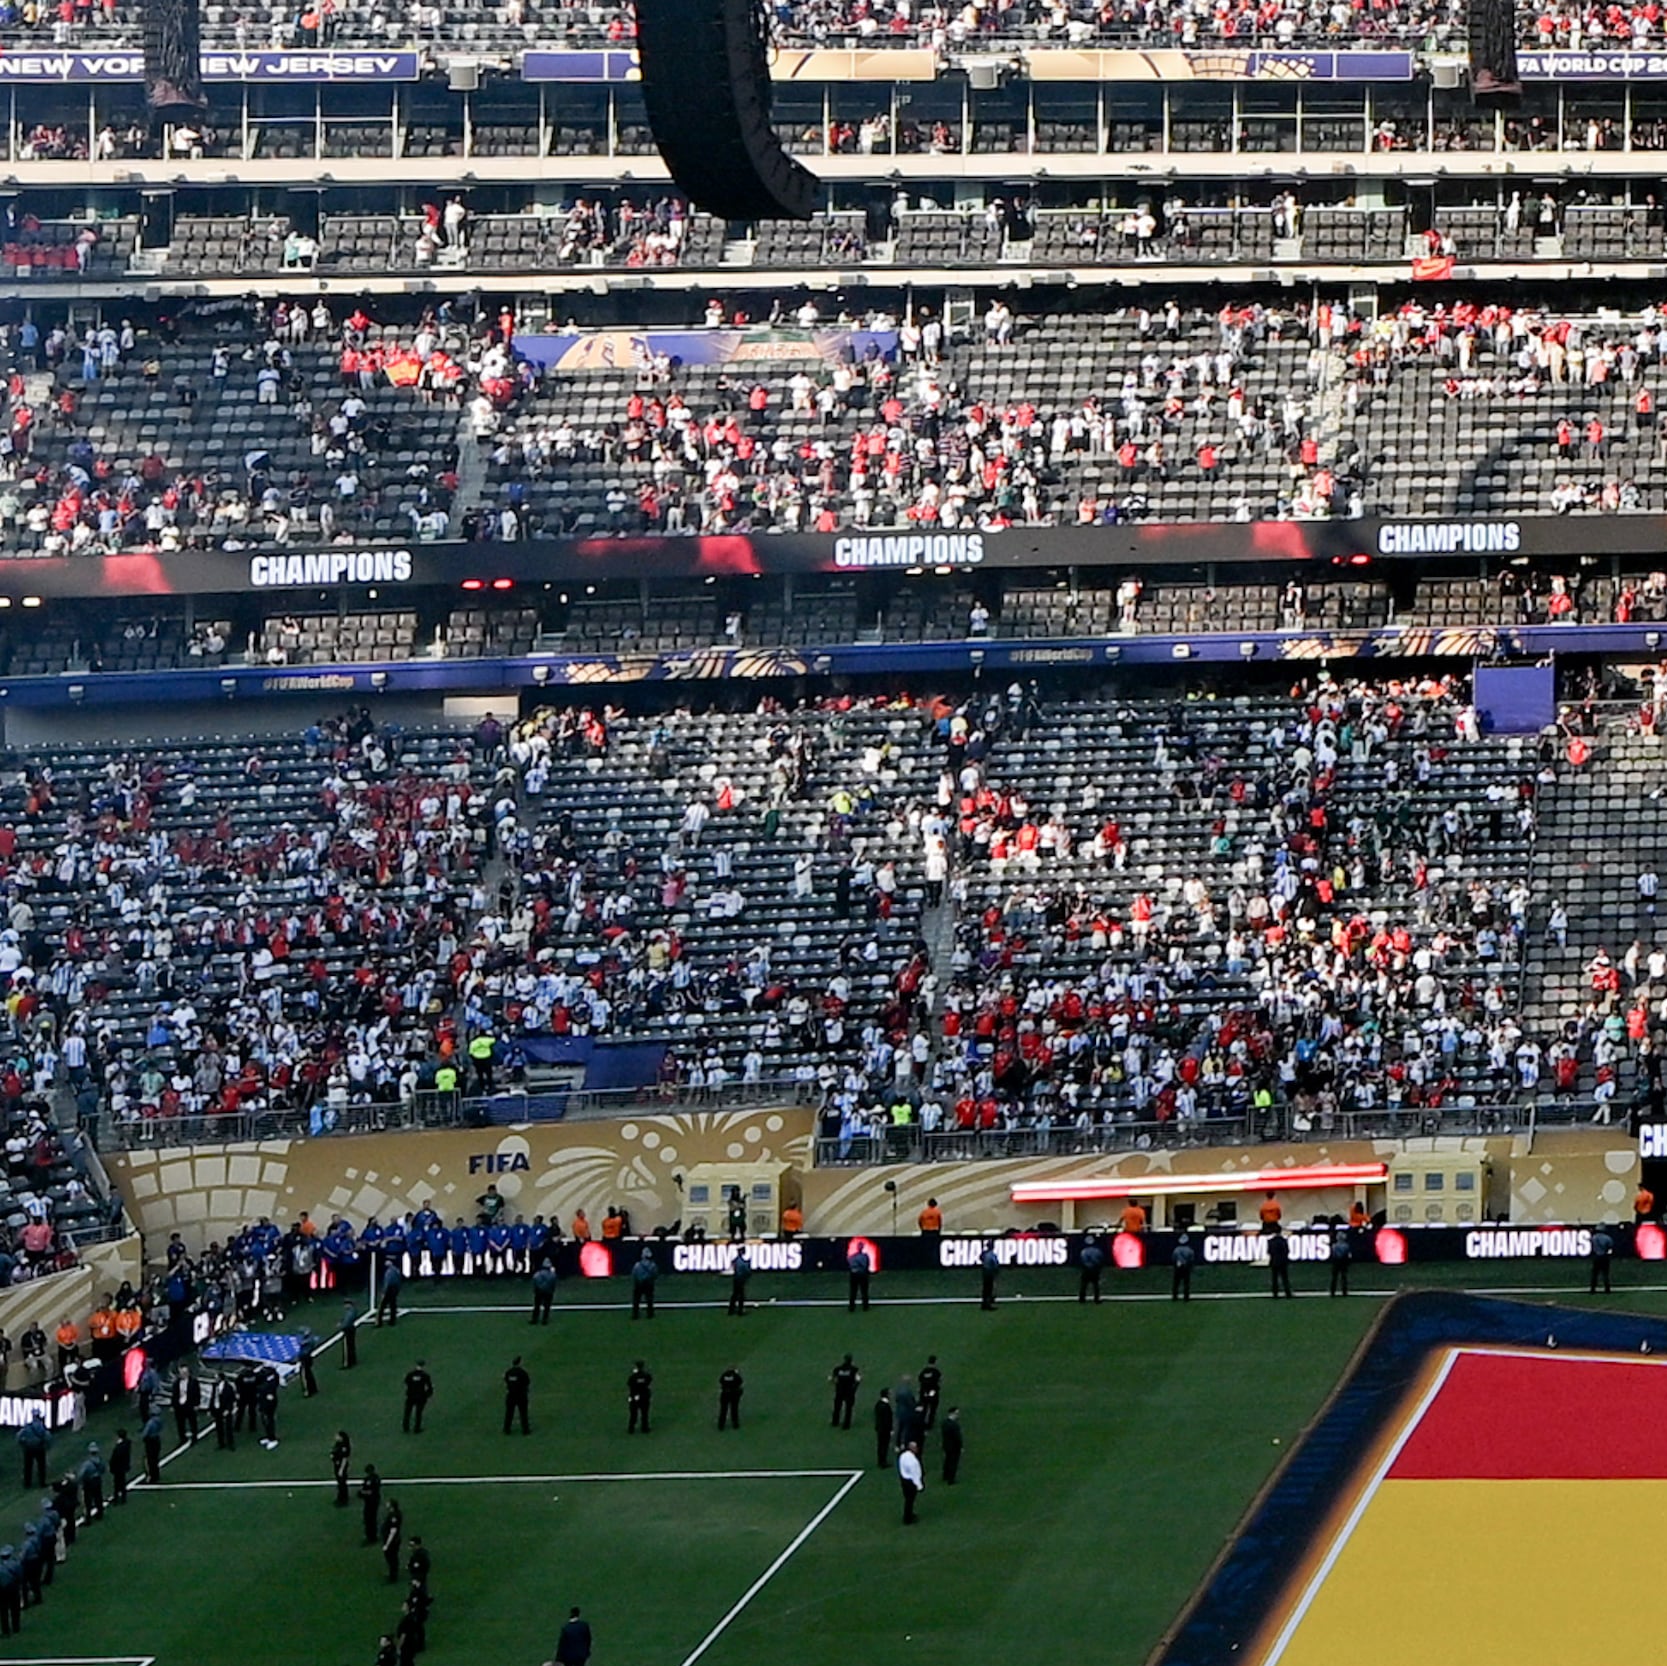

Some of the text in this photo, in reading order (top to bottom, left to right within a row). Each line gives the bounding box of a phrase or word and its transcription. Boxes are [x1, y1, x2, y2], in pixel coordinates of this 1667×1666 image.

[0, 57, 75, 75] NEW
[201, 57, 259, 75] EW
[266, 57, 398, 75] JERSEY
[1544, 57, 1606, 74] WORLD
[1609, 57, 1646, 74] CUP
[834, 530, 983, 567] CHAMPIONS
[1378, 522, 1521, 556] CHAMPIONS
[250, 550, 412, 587] CHAMPIONS
[469, 1151, 530, 1175] FIFA
[1205, 1236, 1331, 1263] CHAMONS
[1466, 1232, 1592, 1258] CHAMPIONS
